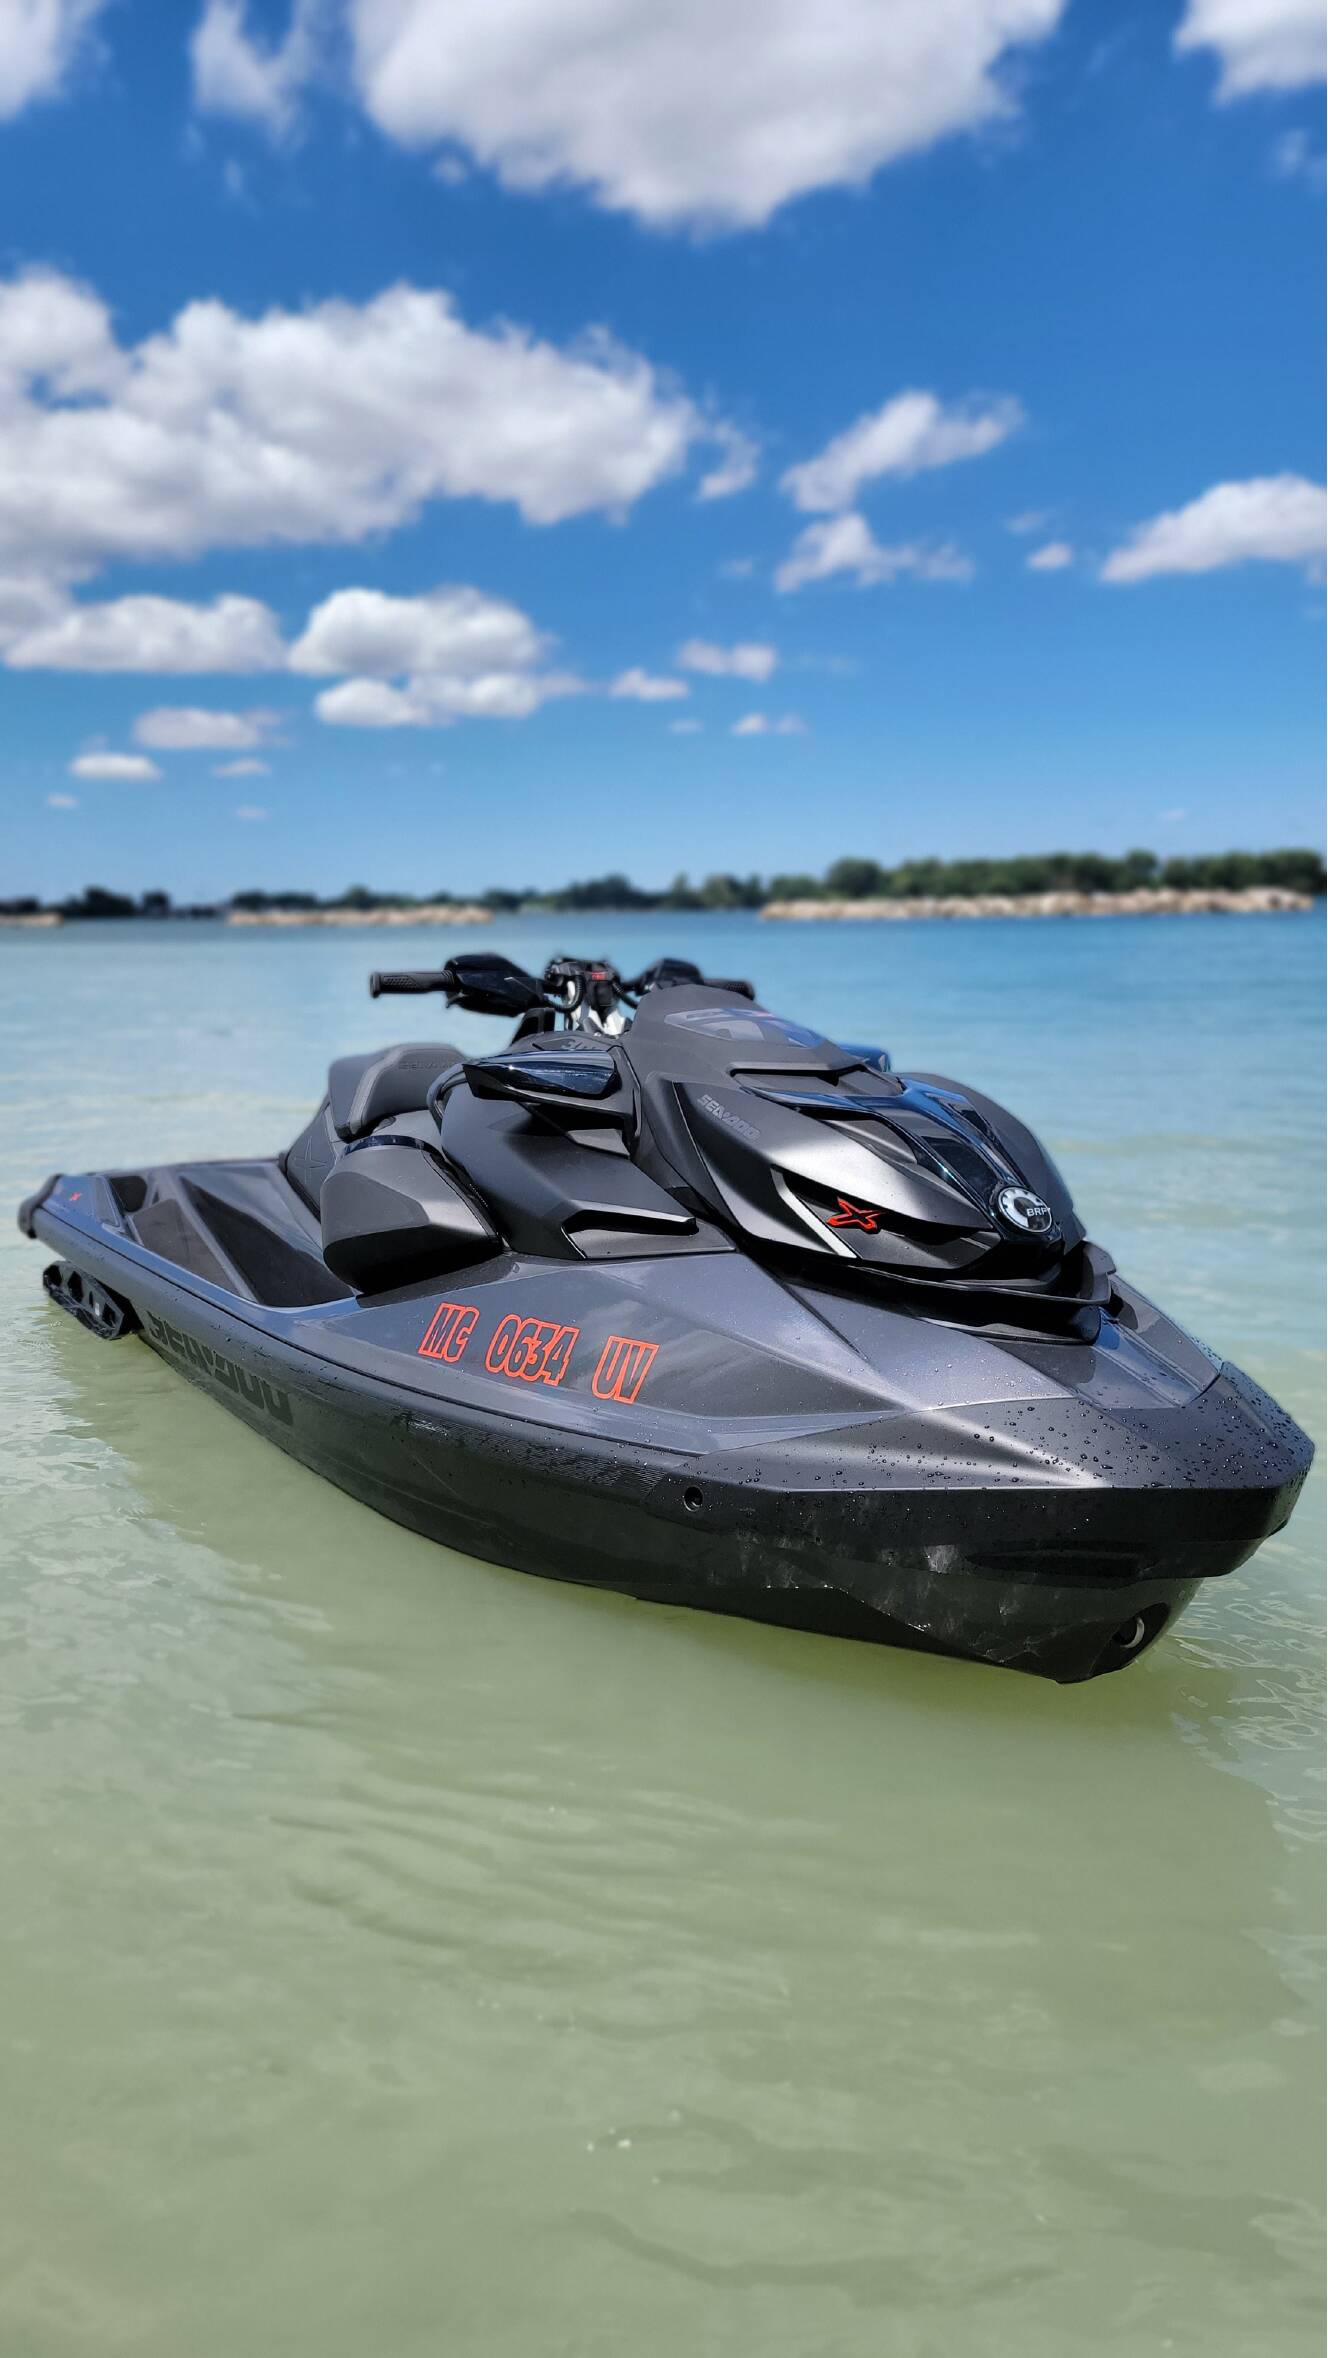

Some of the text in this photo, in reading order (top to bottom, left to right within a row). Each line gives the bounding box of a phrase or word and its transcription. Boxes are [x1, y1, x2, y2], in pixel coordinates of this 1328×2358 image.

[1026, 1207, 1051, 1217] BRP
[418, 1302, 660, 1405] MC 0634 UV
